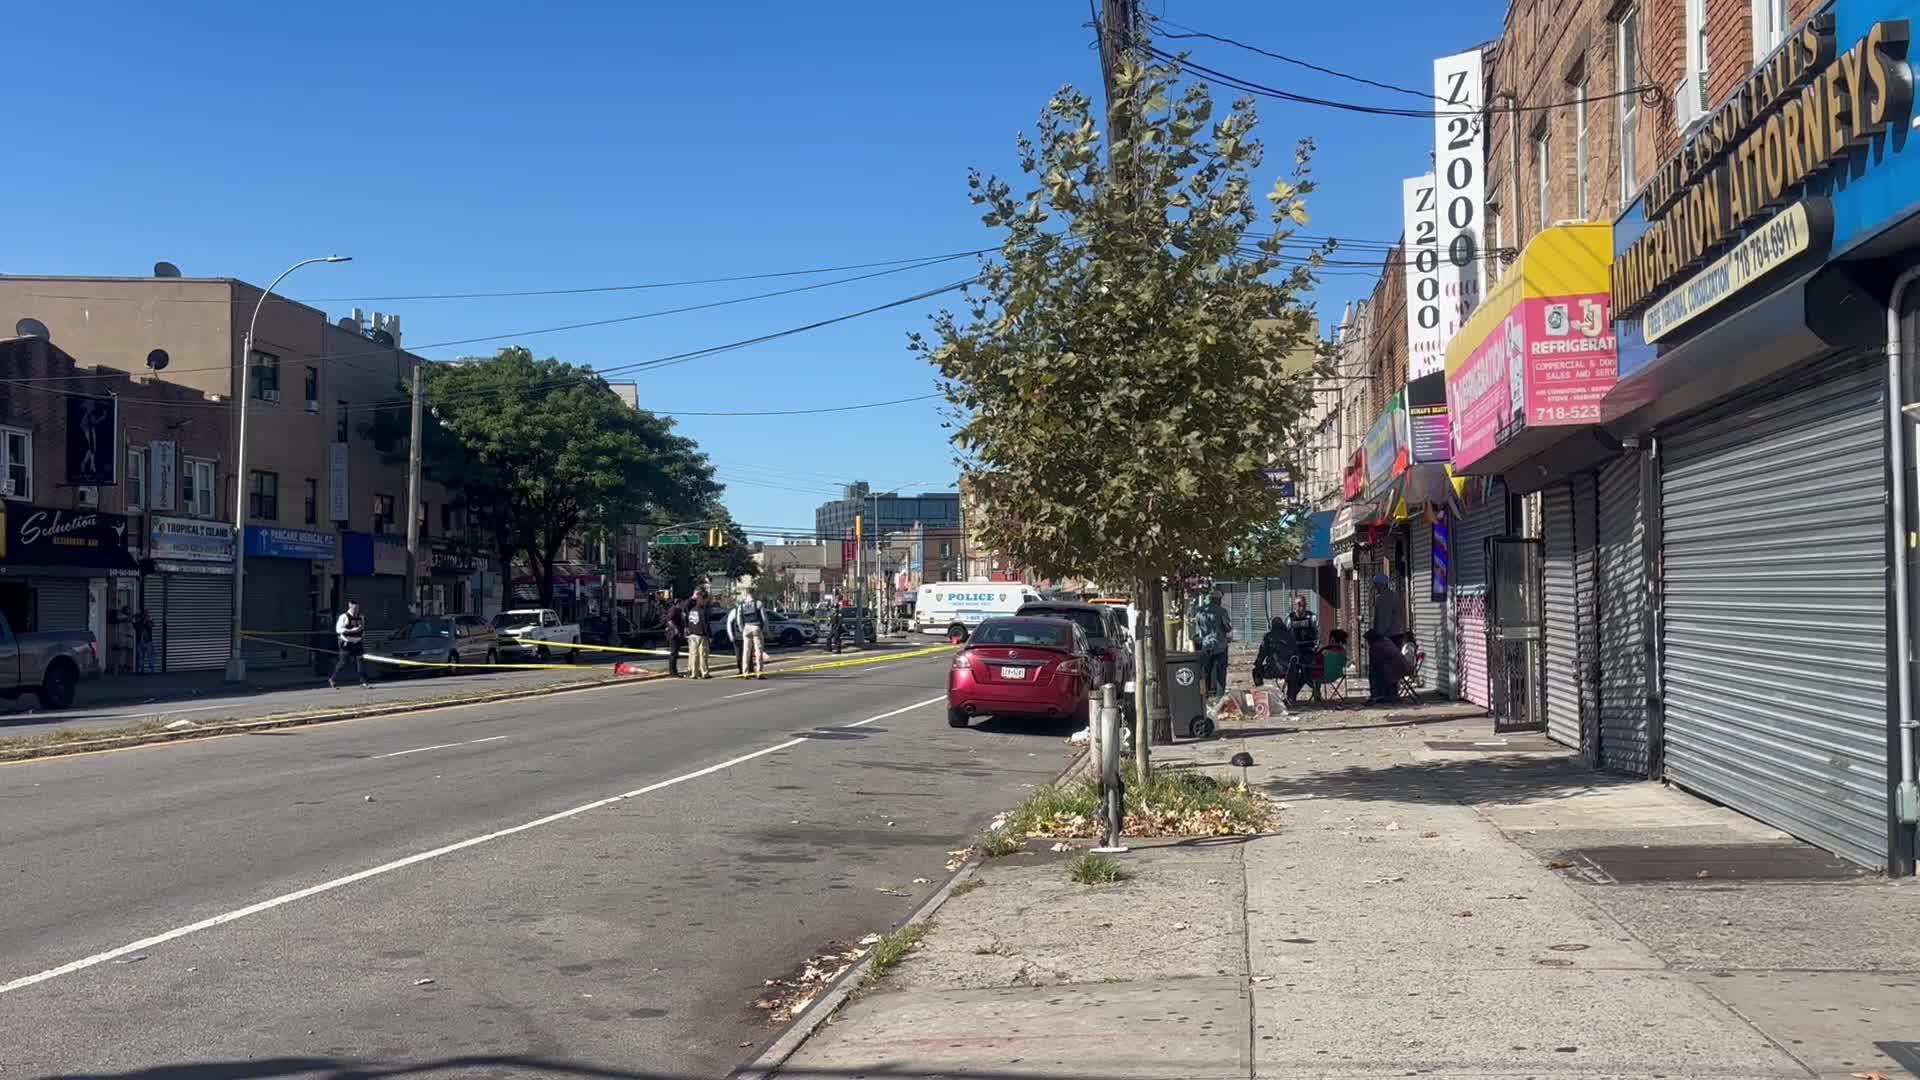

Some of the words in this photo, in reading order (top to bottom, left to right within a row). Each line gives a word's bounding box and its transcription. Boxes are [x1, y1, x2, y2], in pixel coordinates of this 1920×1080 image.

[1692, 19, 1818, 175] ASSOCIATES
[1447, 70, 1474, 267] Z2000
[1608, 168, 1721, 321] IMMIGRATION
[1728, 22, 1887, 231] ATTORNEYS
[1416, 187, 1440, 329] Z2000
[1688, 262, 1729, 312] CONSULTATION
[1734, 247, 1750, 284] 718
[1749, 212, 1798, 273] 764-6911
[1531, 337, 1616, 355] REFRIGERAT
[1535, 362, 1585, 371] COMMERCIAL
[1545, 371, 1570, 380] SALES
[1576, 369, 1591, 378] AND
[1595, 367, 1616, 377] SERV
[1536, 405, 1600, 420] 718-523
[20, 510, 97, 545] Seduction
[948, 592, 994, 601] POLICE
